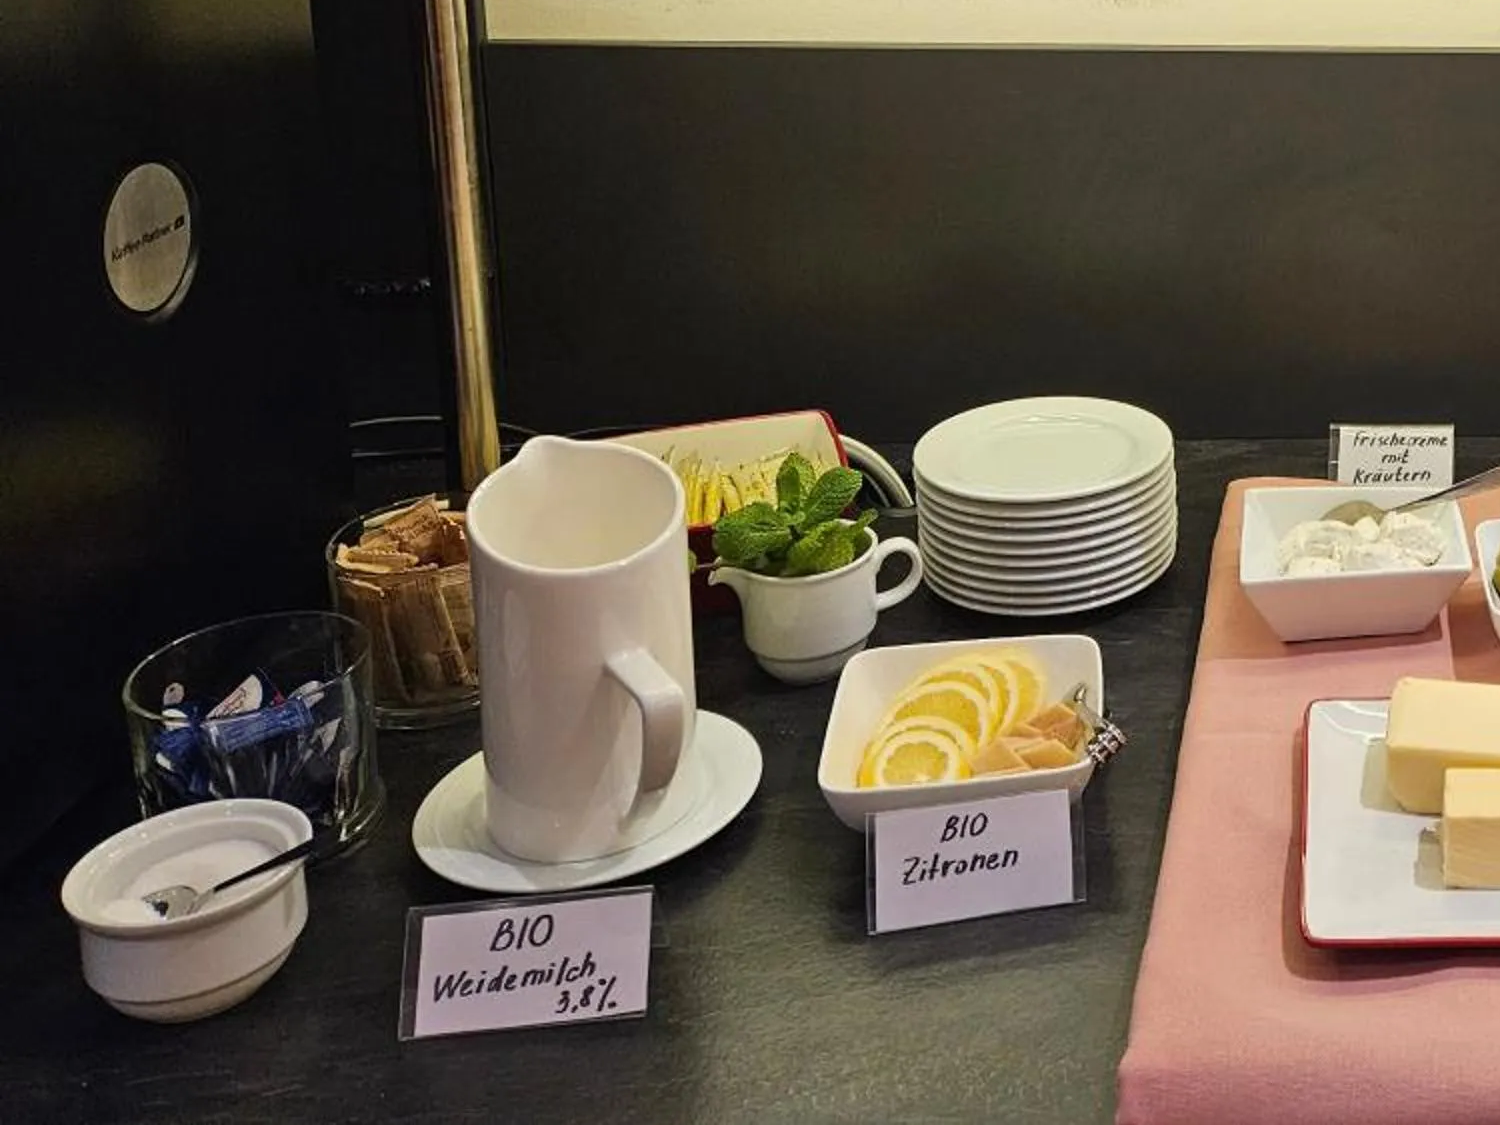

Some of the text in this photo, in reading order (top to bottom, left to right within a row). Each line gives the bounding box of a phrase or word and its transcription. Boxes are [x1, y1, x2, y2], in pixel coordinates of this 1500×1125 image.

[1382, 448, 1409, 464] mit
[1353, 466, 1431, 484] Kräutern
[940, 812, 989, 843] BIO
[902, 849, 1019, 885] Zitronen
[489, 914, 554, 952] BIO
[433, 951, 597, 1003] Weidemilch
